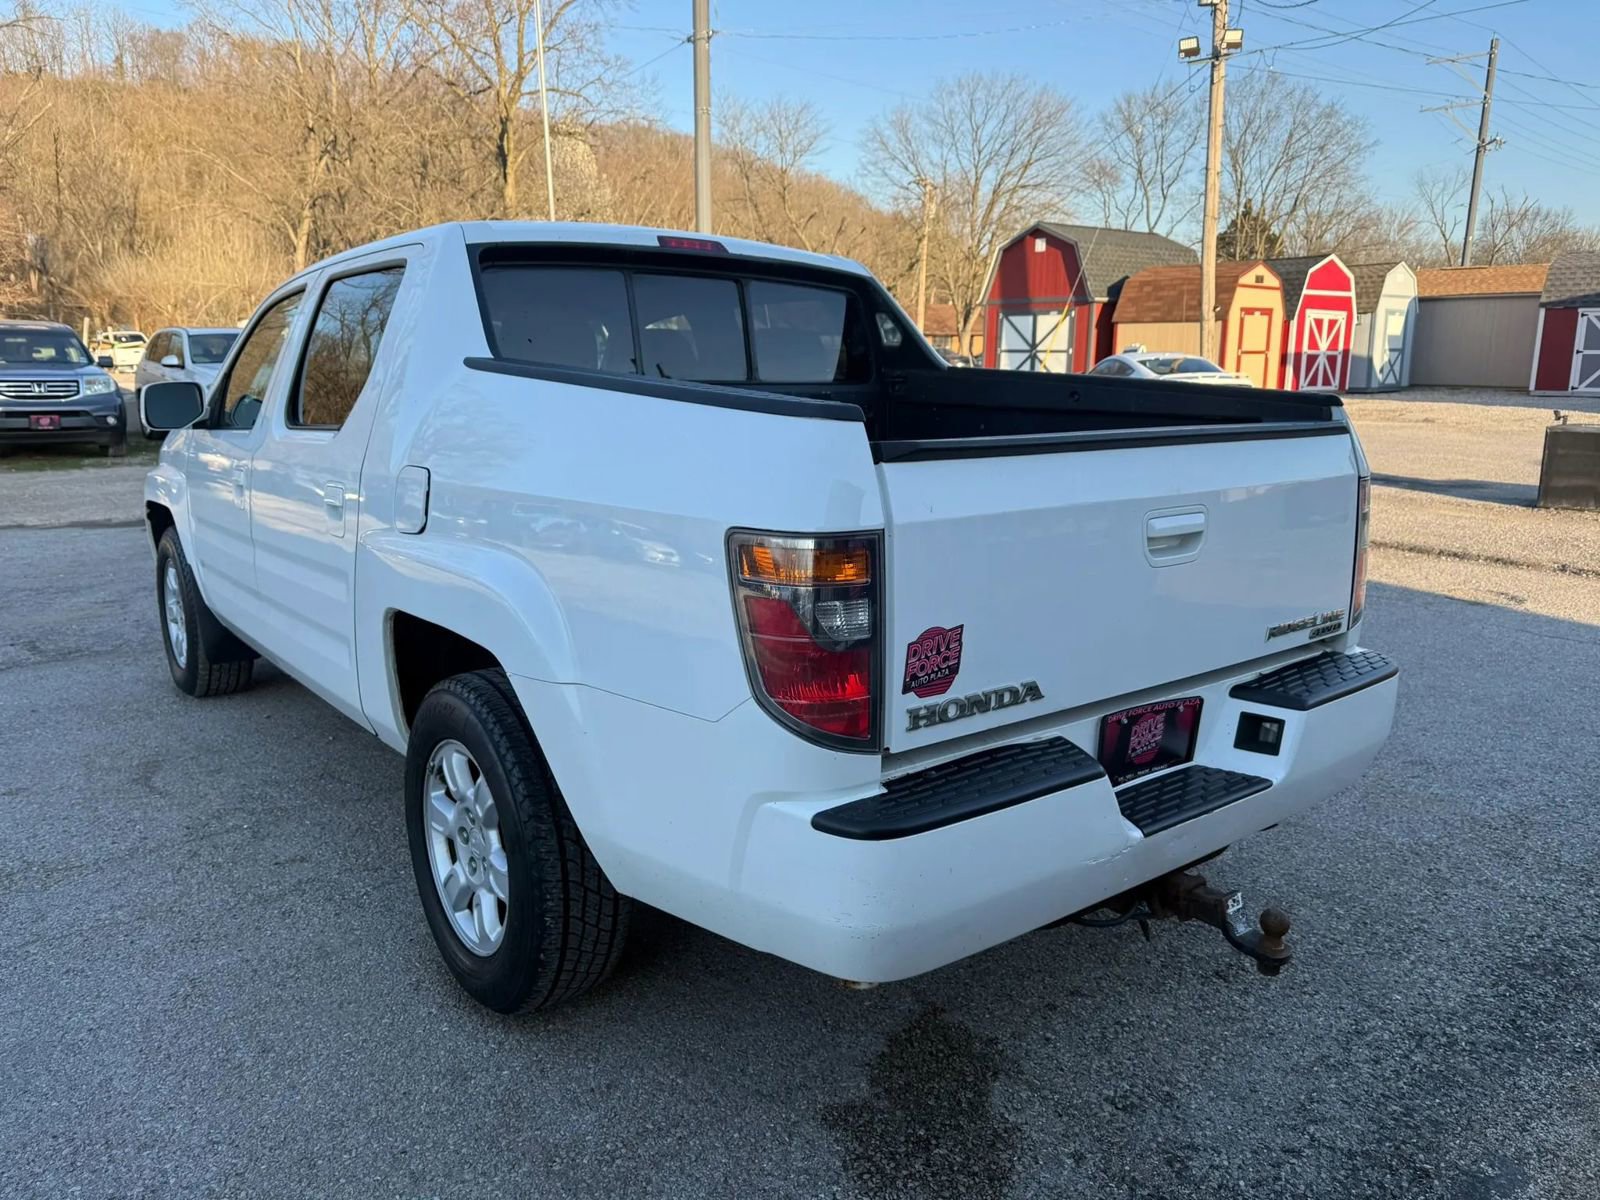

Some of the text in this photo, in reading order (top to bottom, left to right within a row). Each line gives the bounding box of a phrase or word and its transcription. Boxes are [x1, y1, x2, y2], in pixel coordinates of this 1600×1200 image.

[908, 628, 961, 663] DRIVE
[906, 646, 960, 681] FORCE
[911, 669, 949, 688] AUTO PLAZA
[906, 680, 1045, 732] HONDA
[1153, 702, 1175, 711] AUTO
[1131, 712, 1165, 738] DRIVE
